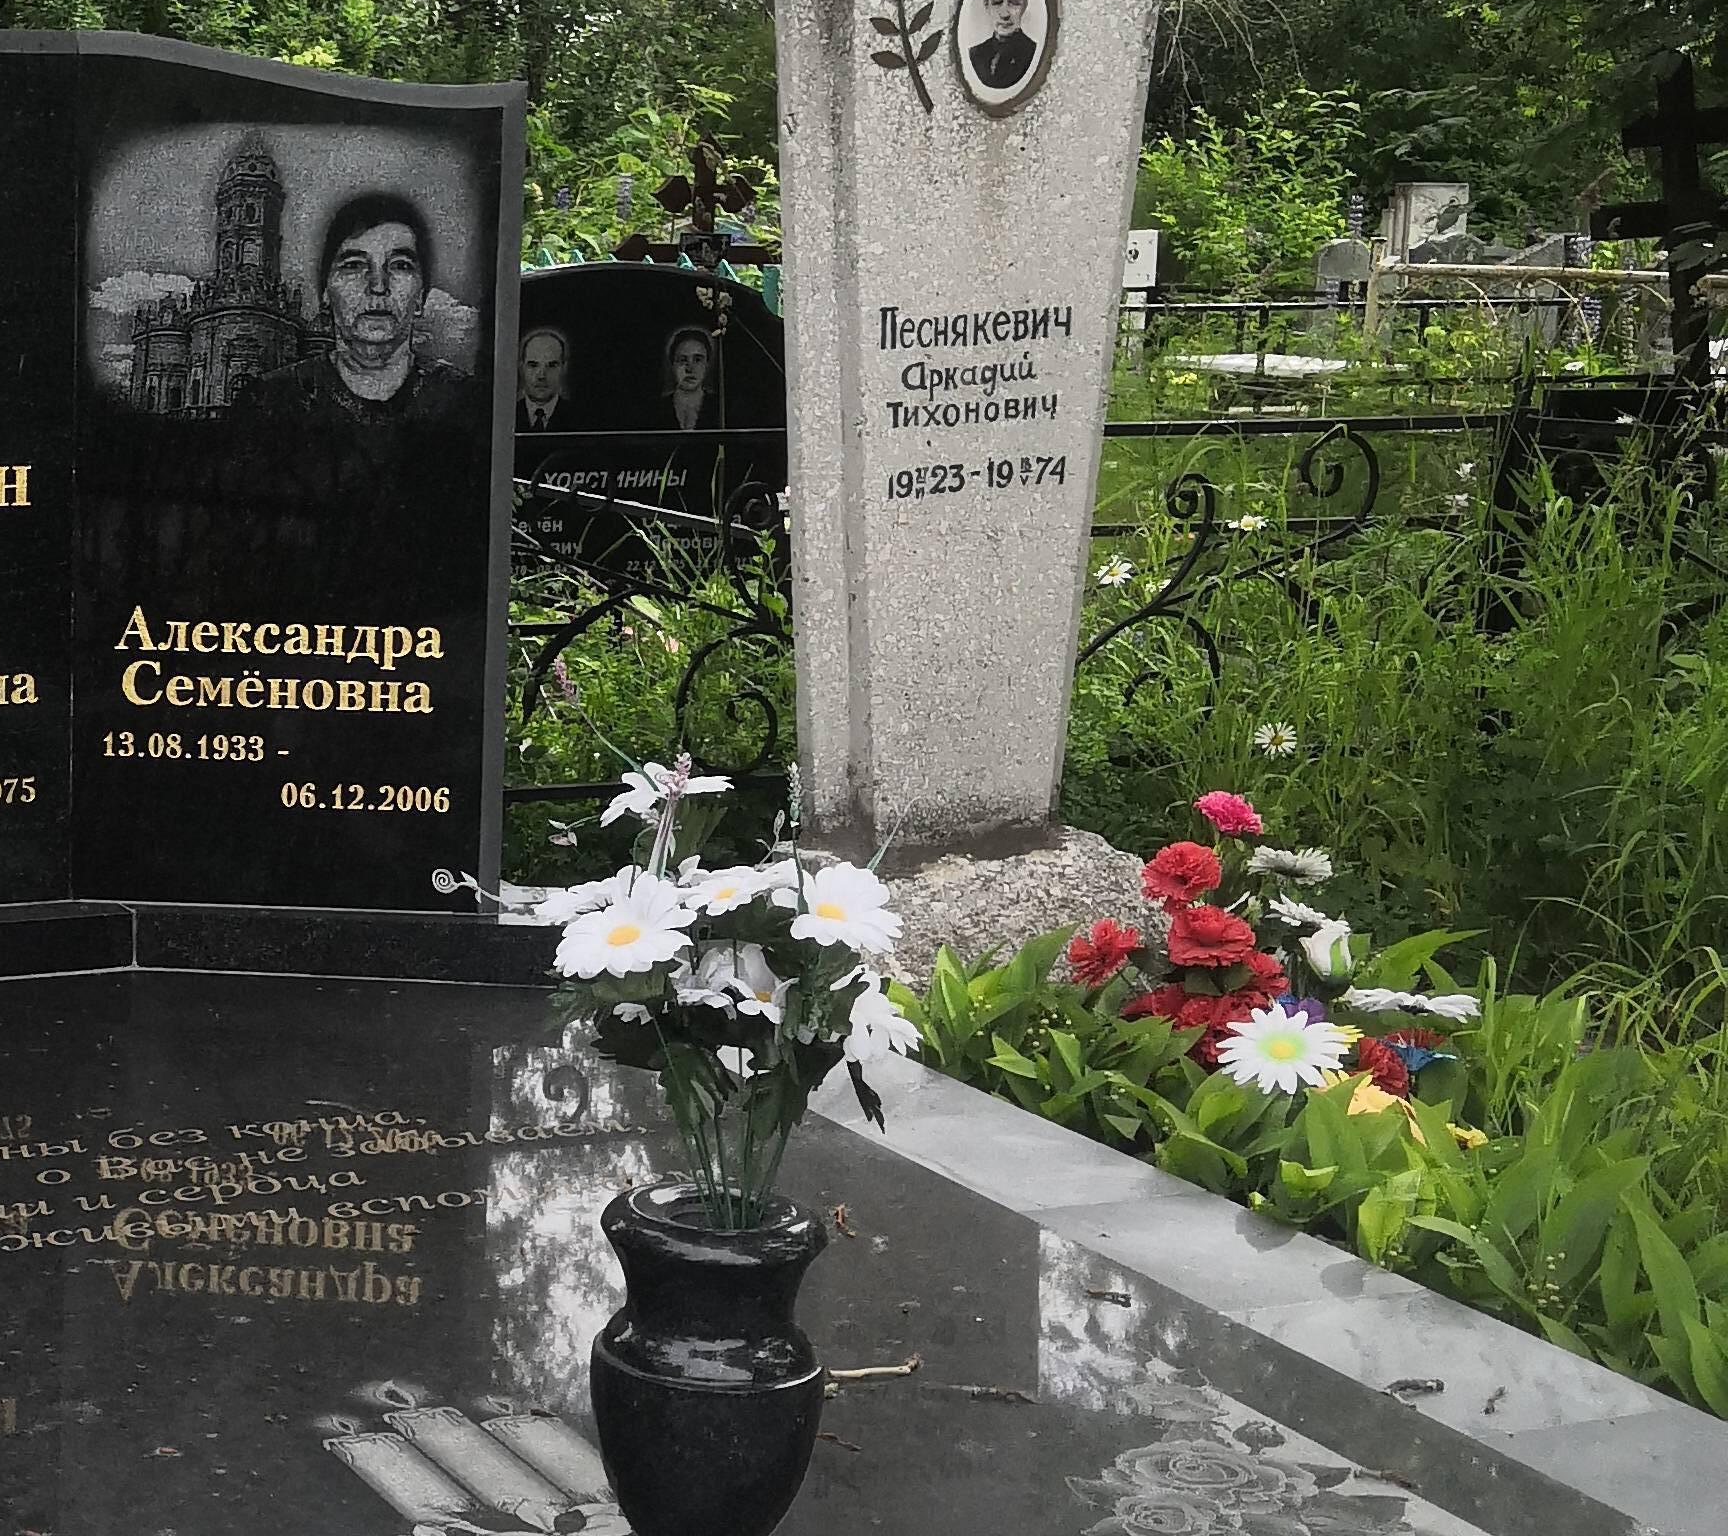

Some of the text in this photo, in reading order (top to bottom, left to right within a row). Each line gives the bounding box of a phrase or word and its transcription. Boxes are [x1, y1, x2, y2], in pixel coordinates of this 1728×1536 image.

[880, 306, 1071, 349] Песнякевич
[901, 351, 1037, 401] Аркадий
[887, 395, 1058, 428] Тихонович
[114, 606, 444, 670] Александра
[122, 659, 434, 713] Семёновна
[103, 731, 264, 762] 13.08.1933
[280, 782, 450, 813] 06.12.2006
[108, 1127, 208, 1149] без
[36, 1169, 71, 1185] о
[94, 1155, 218, 1180] Вас
[233, 1146, 308, 1166] не
[75, 1193, 117, 1212] и
[138, 1169, 368, 1206] сердца
